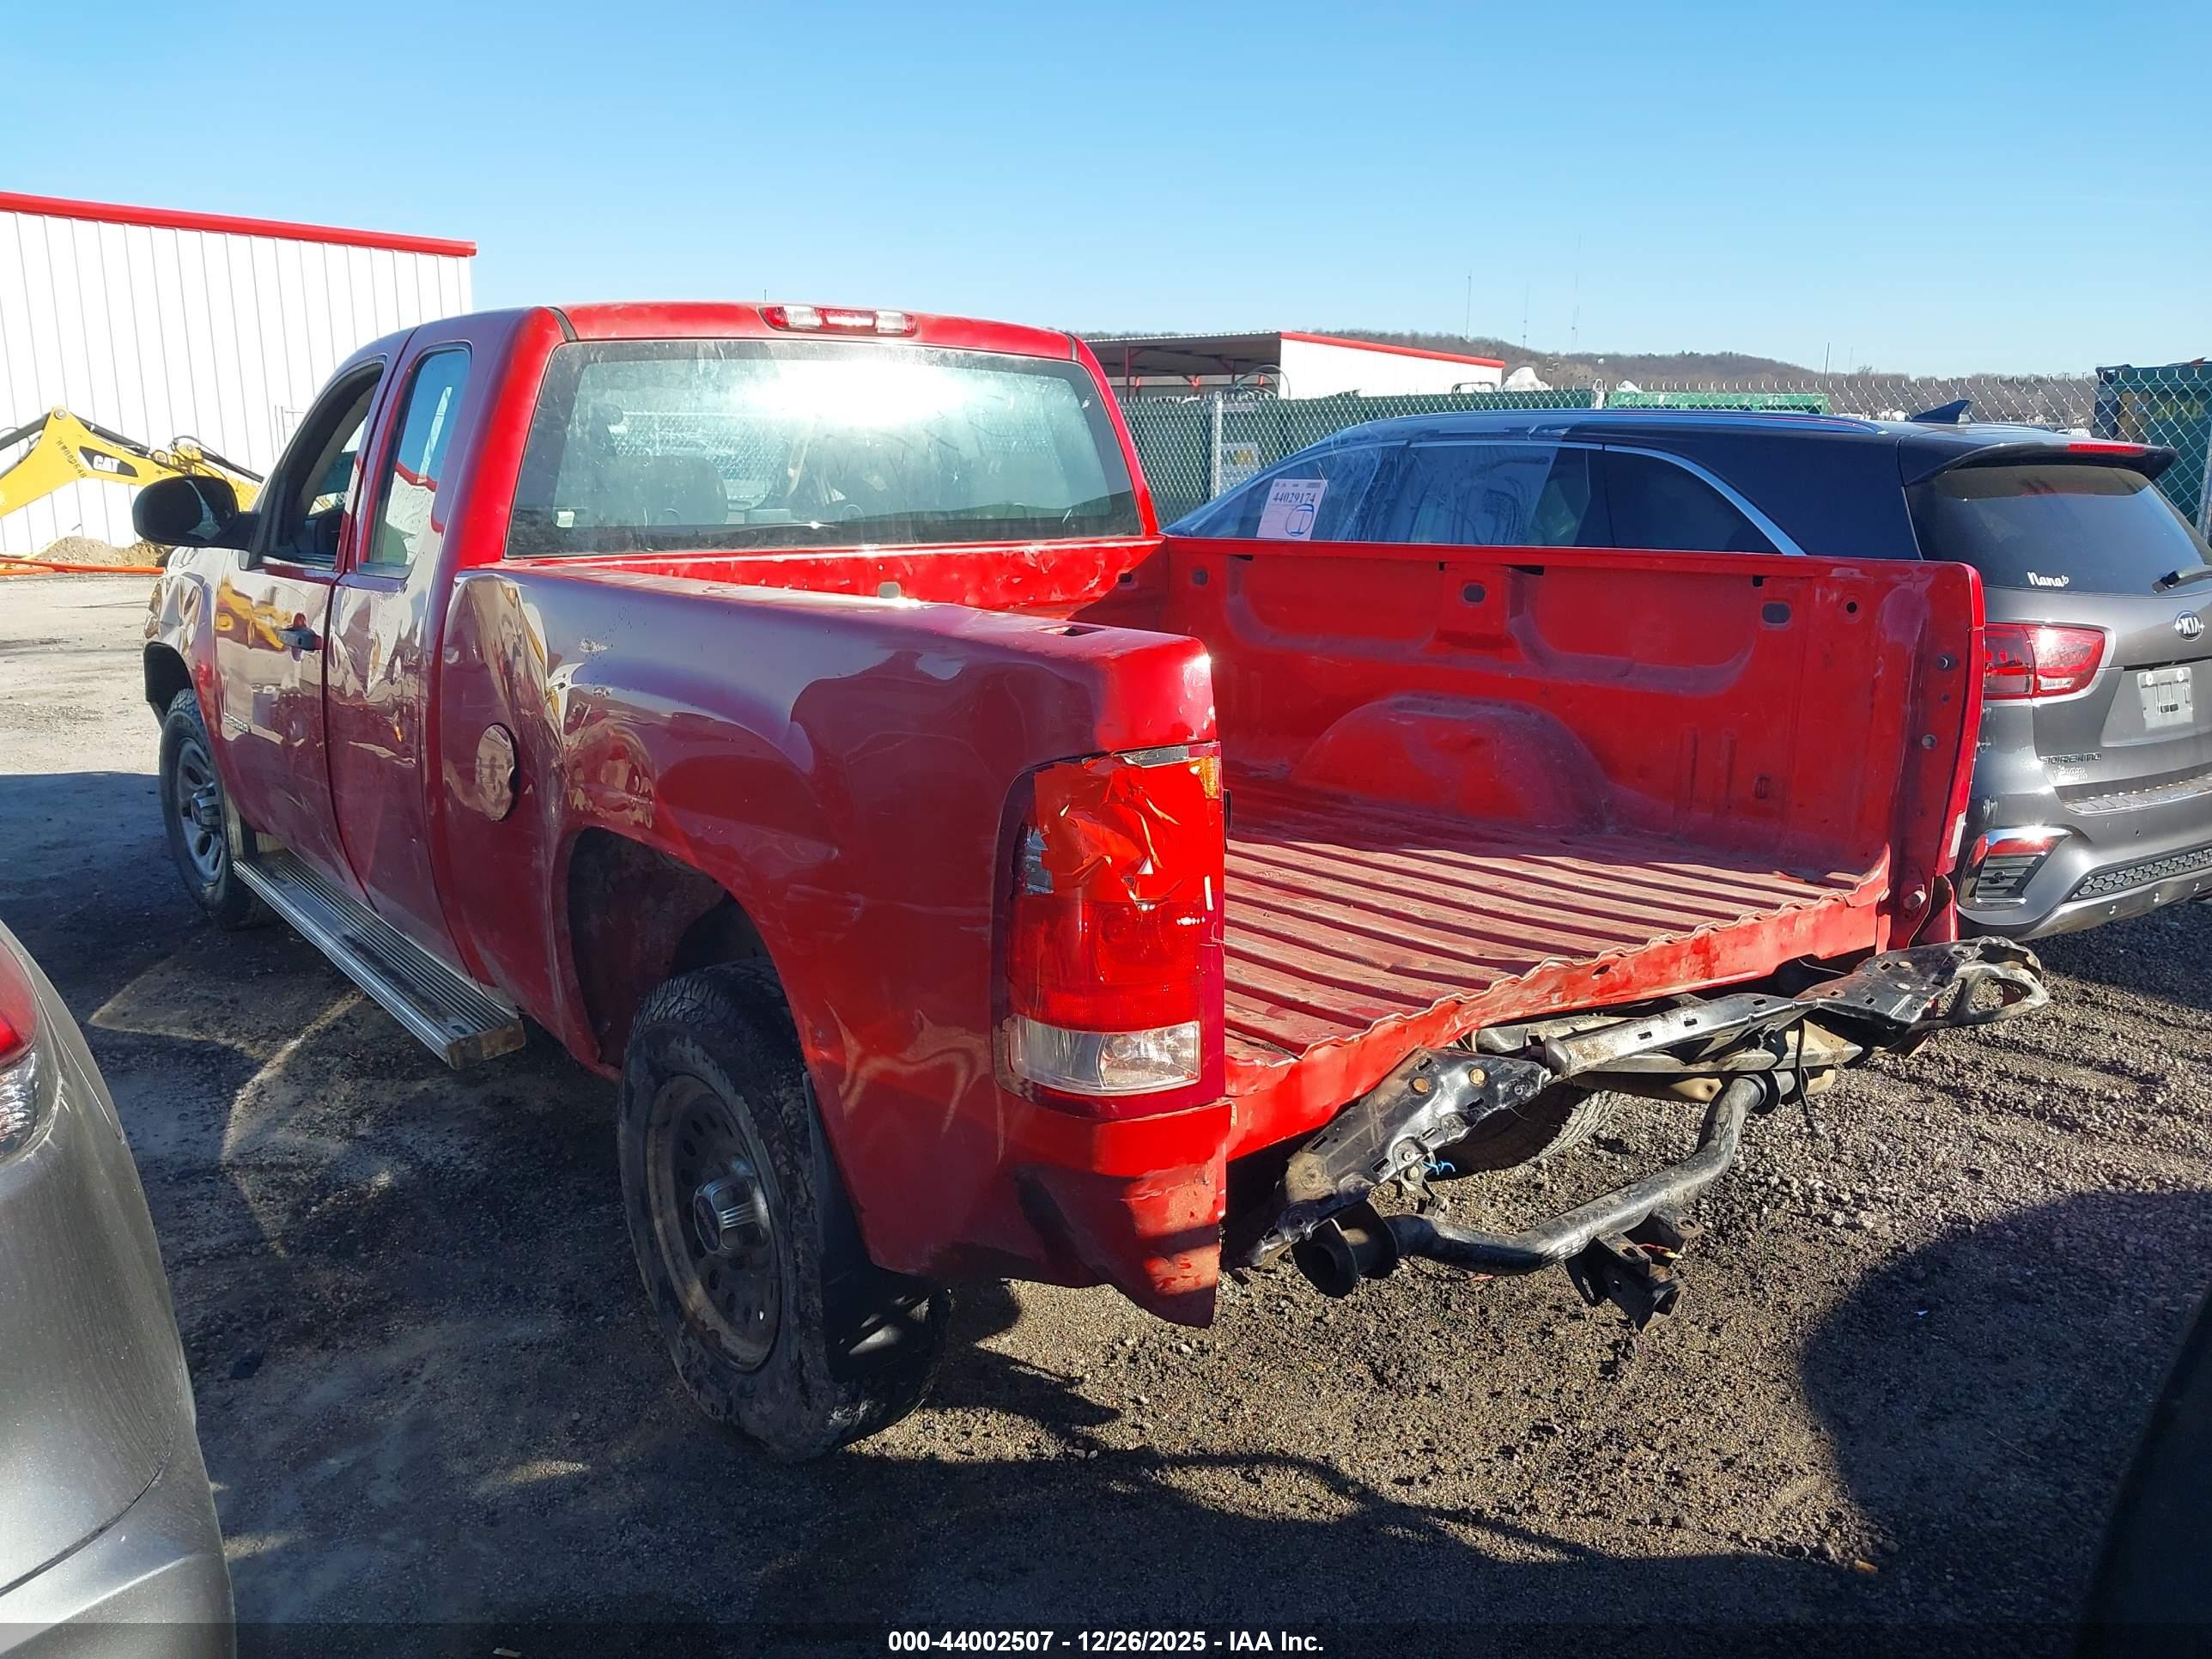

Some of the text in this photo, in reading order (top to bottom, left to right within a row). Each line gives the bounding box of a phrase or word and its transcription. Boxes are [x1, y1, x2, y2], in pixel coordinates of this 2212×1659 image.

[93, 455, 120, 473] CAT
[1273, 491, 1316, 504] 44029174
[2027, 571, 2063, 587] Nana
[2180, 617, 2201, 634] KIA
